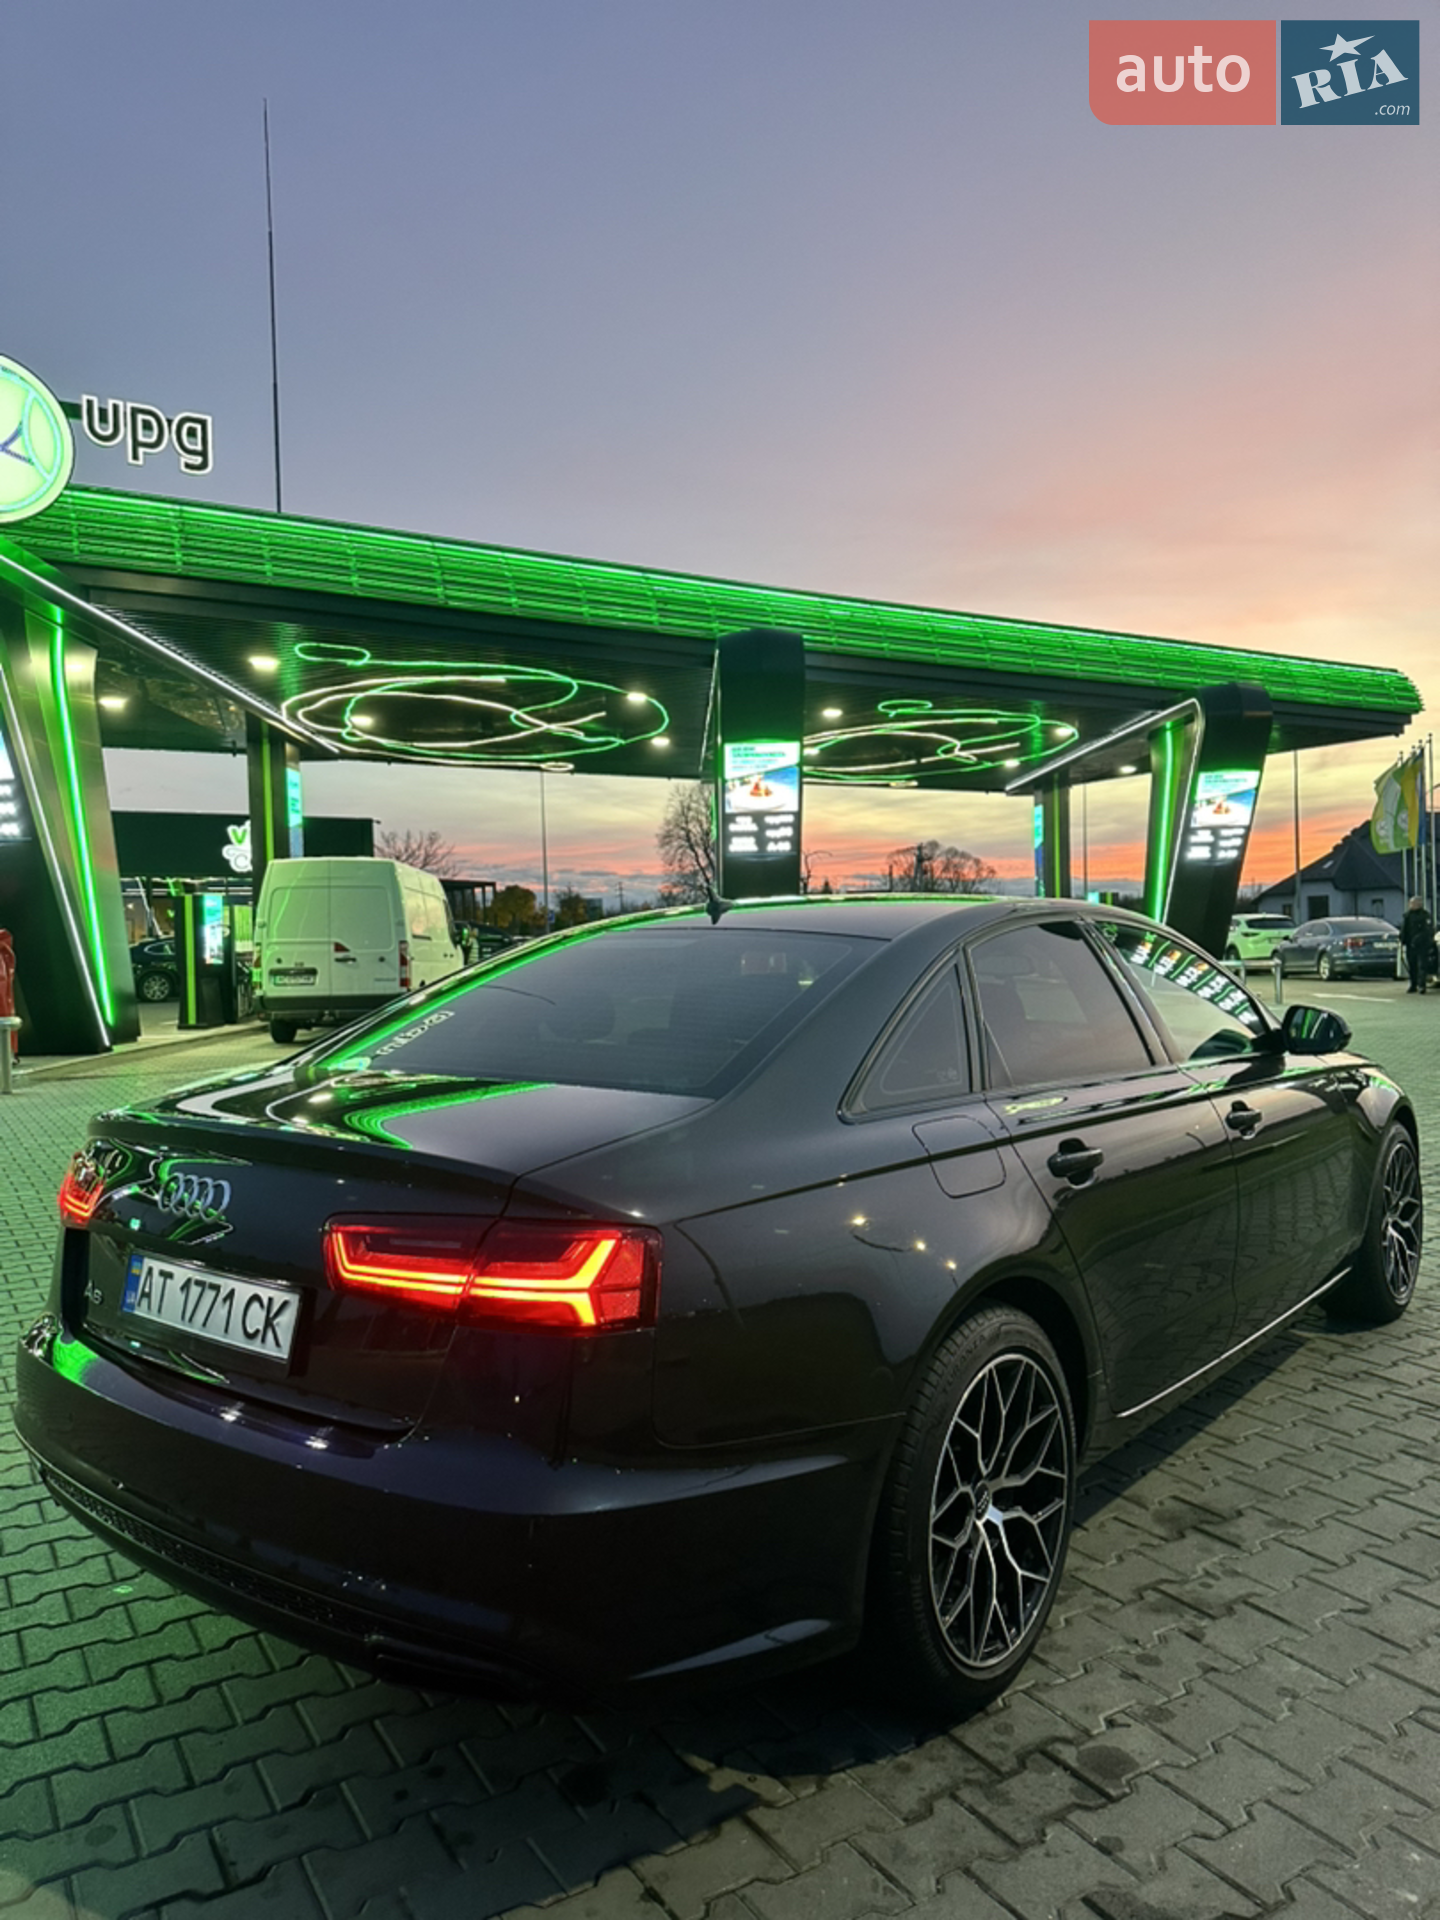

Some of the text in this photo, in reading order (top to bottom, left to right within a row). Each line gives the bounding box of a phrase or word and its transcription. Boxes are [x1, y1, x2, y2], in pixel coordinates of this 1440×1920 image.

[82, 394, 213, 475] upg
[137, 1265, 291, 1349] AT 1771 CK
